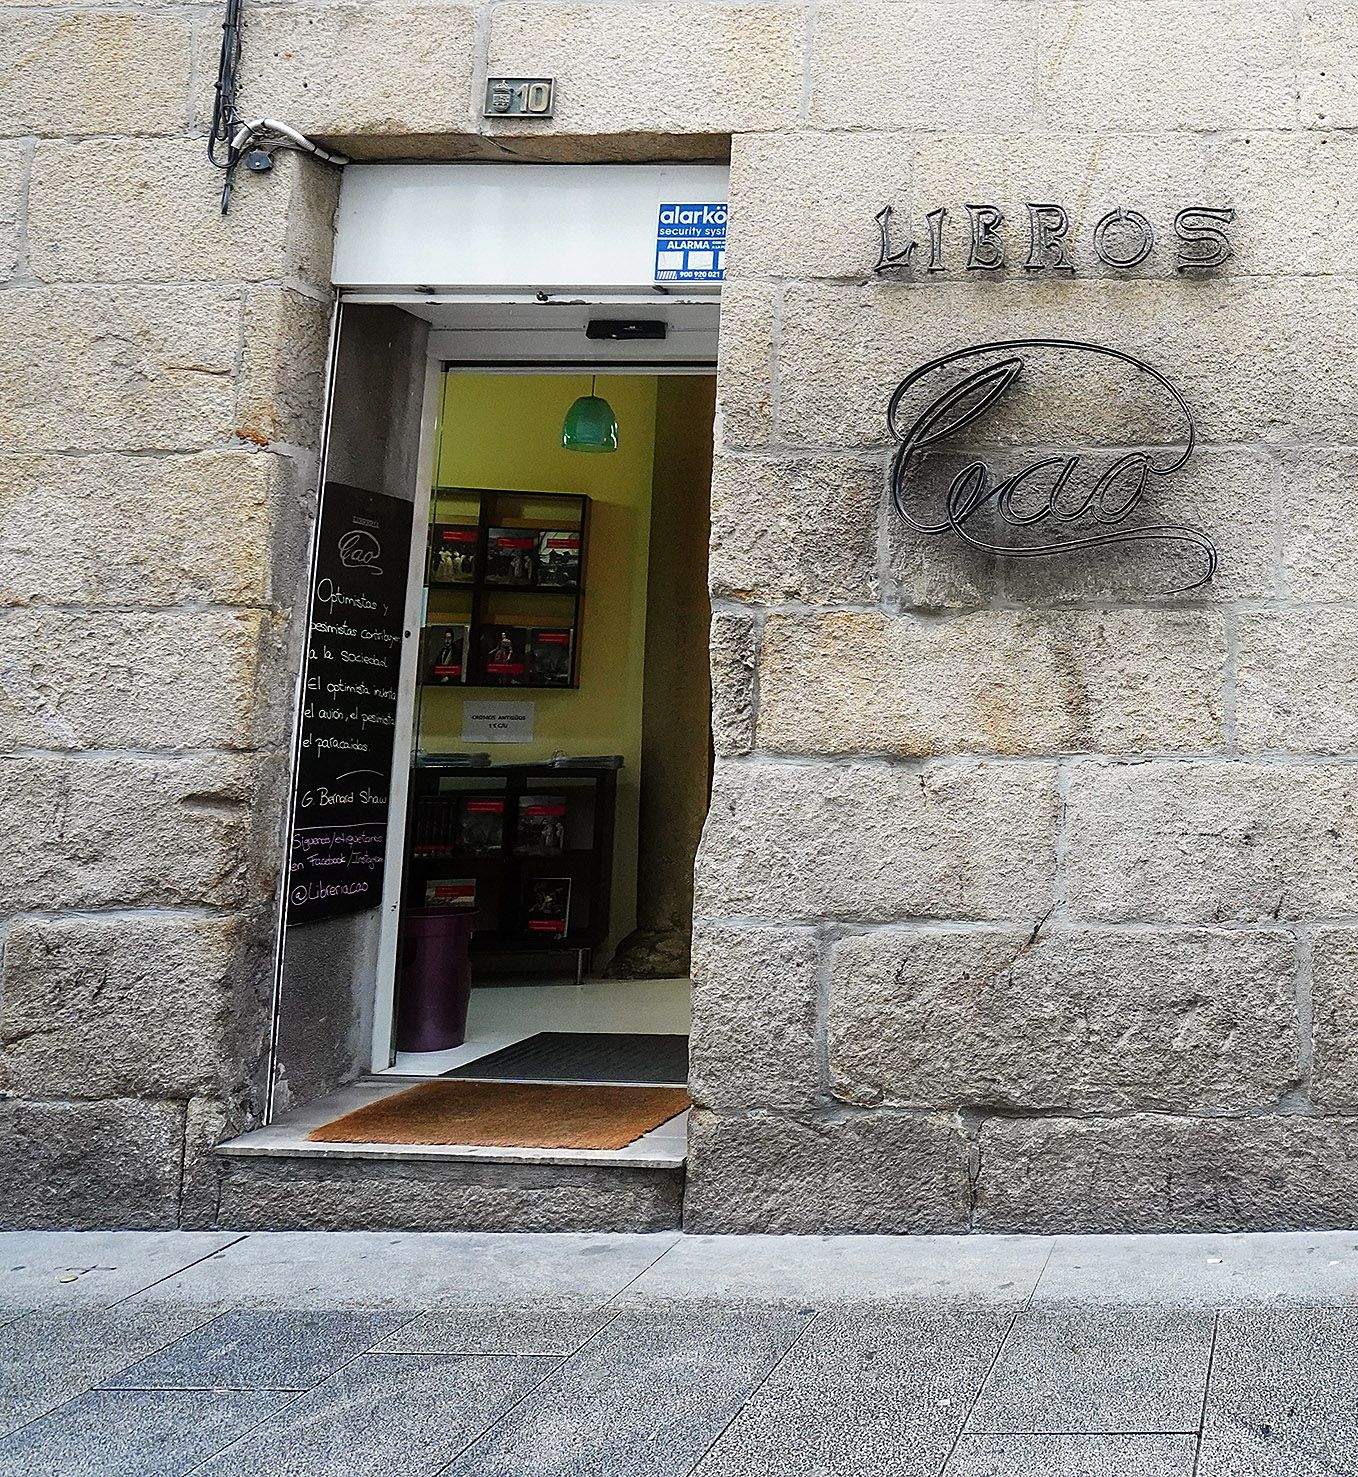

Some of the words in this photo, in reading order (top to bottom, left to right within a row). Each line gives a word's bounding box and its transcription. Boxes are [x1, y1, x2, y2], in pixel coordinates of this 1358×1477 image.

[517, 82, 550, 112] 10
[660, 227, 702, 237] security
[873, 202, 1237, 274] LIBROS
[667, 240, 711, 250] ALARMA
[317, 578, 378, 615] Optimistas
[309, 649, 319, 660] a
[323, 645, 334, 660] la
[307, 676, 321, 690] El
[326, 679, 371, 700] optimista
[304, 702, 315, 718] el
[302, 733, 312, 748] el
[316, 786, 354, 807] Bernard
[359, 786, 388, 804] Shaw
